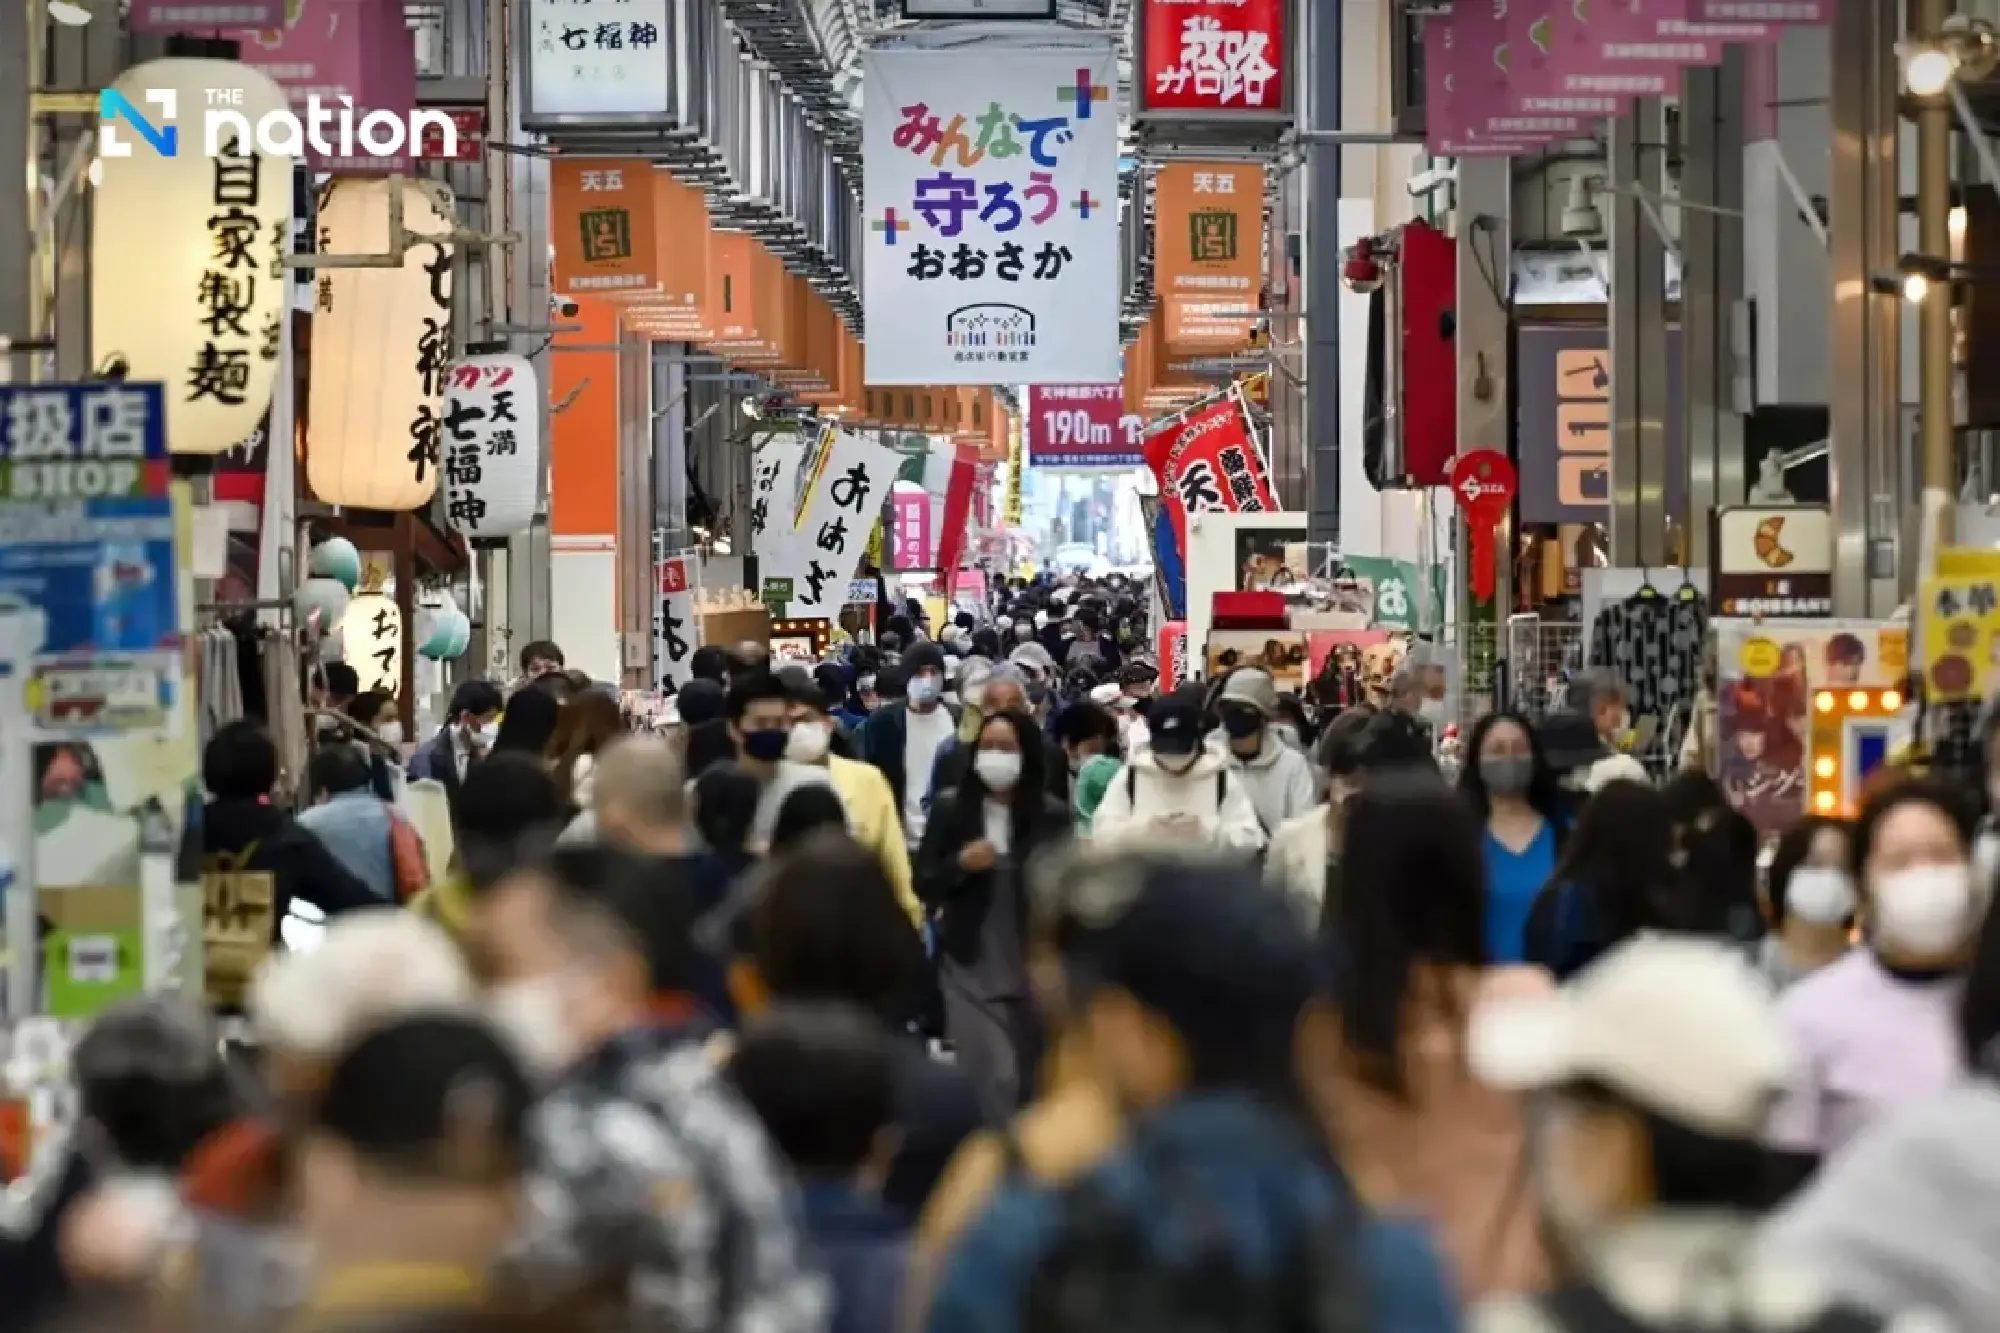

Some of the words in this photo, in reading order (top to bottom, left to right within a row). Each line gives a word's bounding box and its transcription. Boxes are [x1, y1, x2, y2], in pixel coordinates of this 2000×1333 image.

[893, 102, 1073, 168] みんなで
[912, 171, 1058, 237] 守ろう
[1193, 171, 1236, 193] 天五
[906, 241, 1073, 281] おおさか
[487, 391, 517, 455] 天満
[1043, 409, 1112, 445] 190m
[444, 398, 486, 529] 七福神
